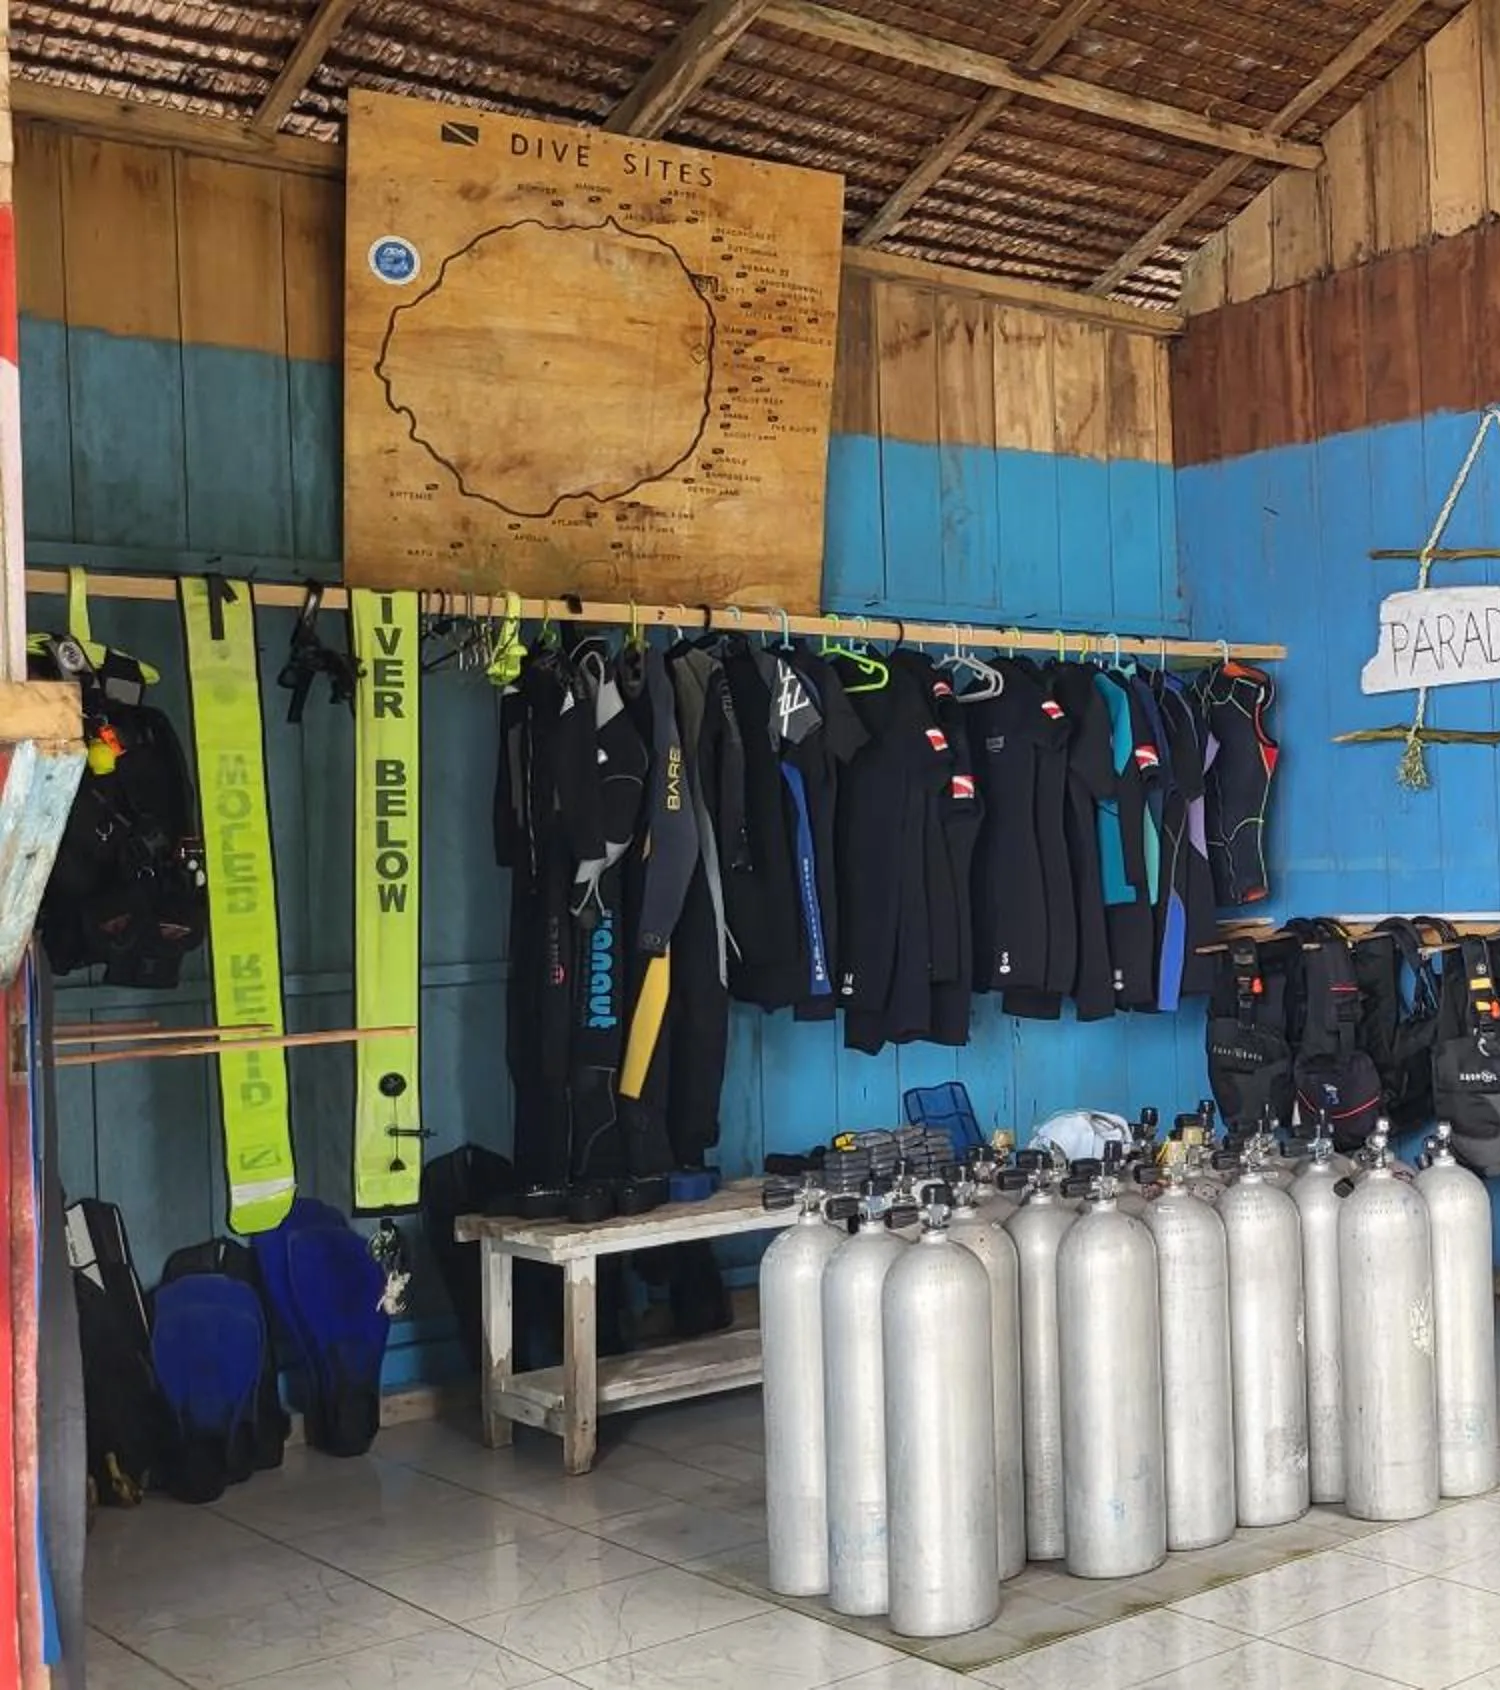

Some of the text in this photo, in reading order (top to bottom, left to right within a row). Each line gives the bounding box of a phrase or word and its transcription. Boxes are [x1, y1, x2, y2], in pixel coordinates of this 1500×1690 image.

[511, 132, 714, 188] DIVE SITES
[371, 588, 409, 913] IVER BELOW
[666, 746, 681, 812] BARE
